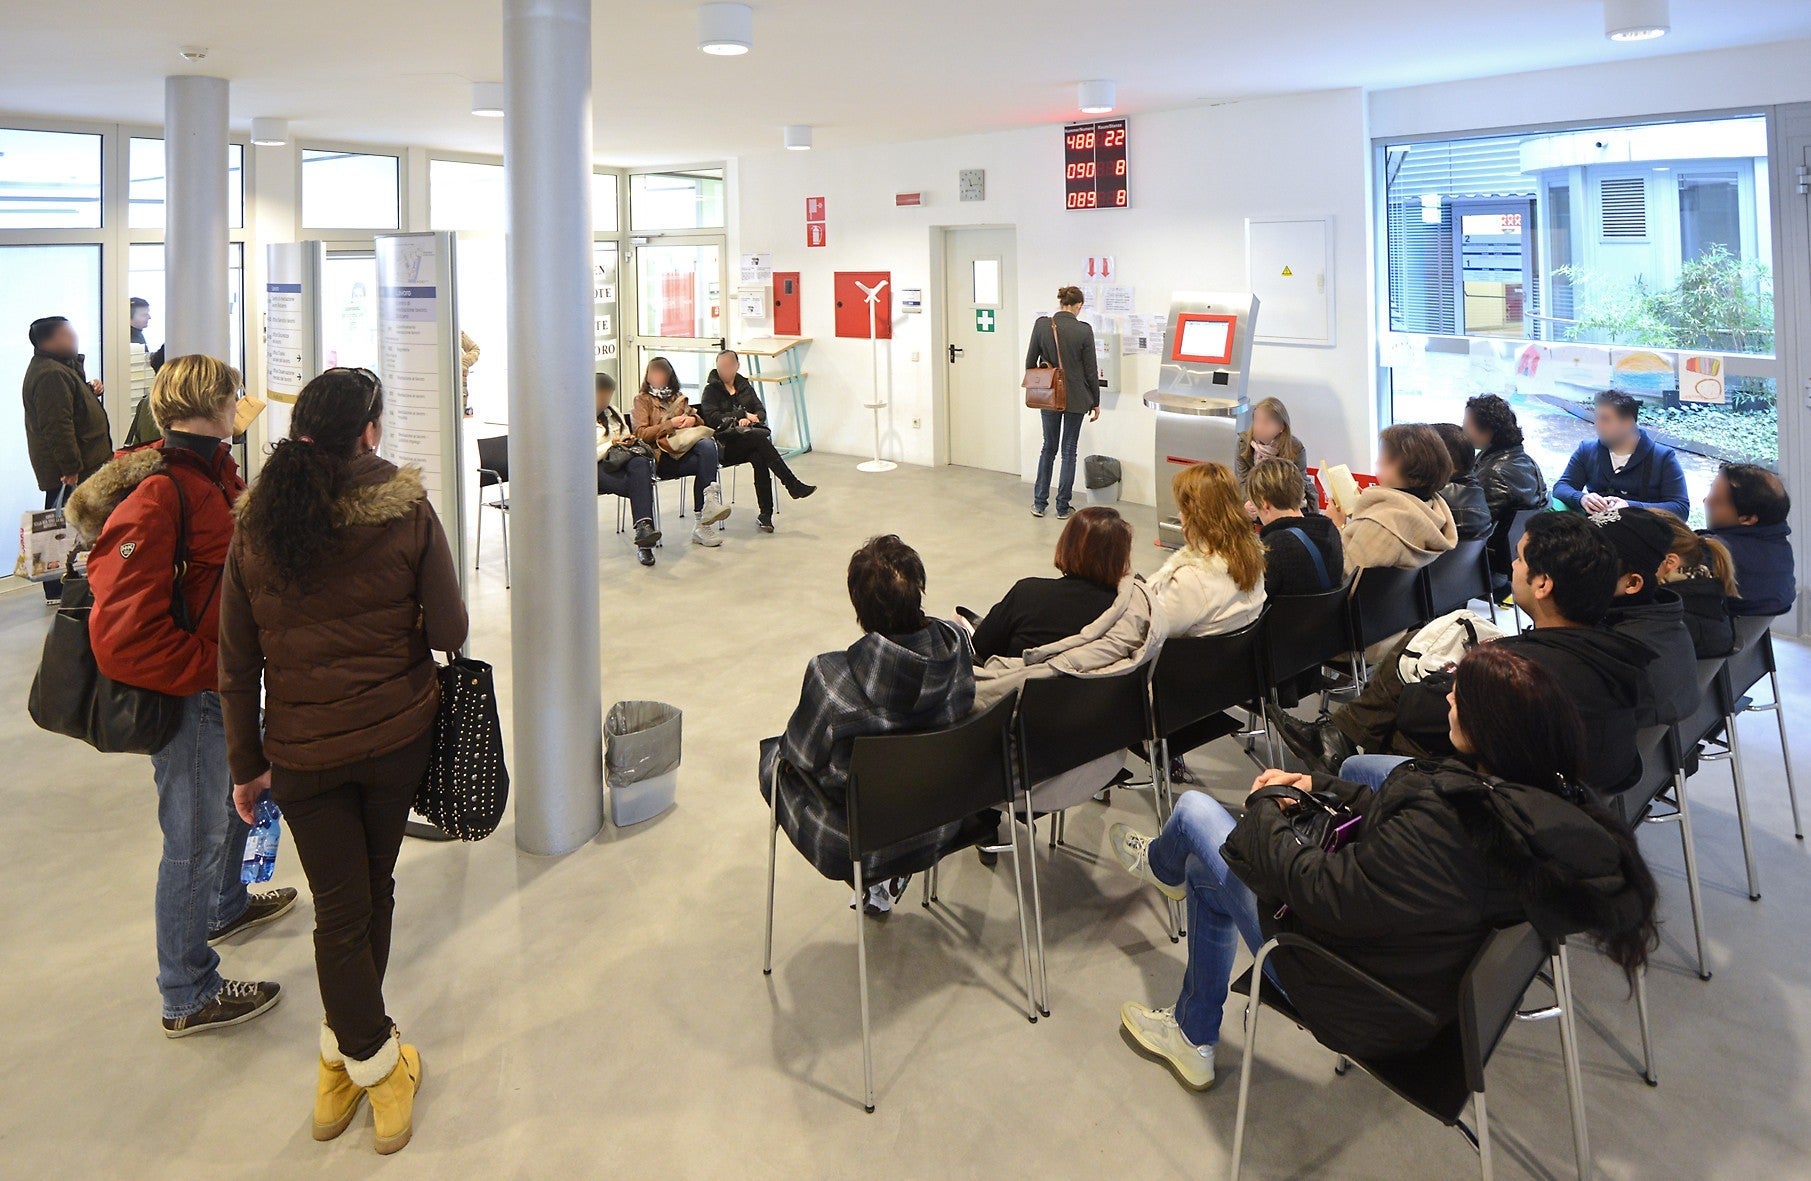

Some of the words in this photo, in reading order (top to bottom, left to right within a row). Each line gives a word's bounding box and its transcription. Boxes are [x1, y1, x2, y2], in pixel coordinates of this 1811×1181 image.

[1067, 133, 1095, 149] 488
[1105, 130, 1125, 146] 22
[1067, 162, 1096, 179] 090
[1116, 159, 1125, 175] 8
[1068, 191, 1096, 208] 089
[1116, 189, 1126, 205] 8
